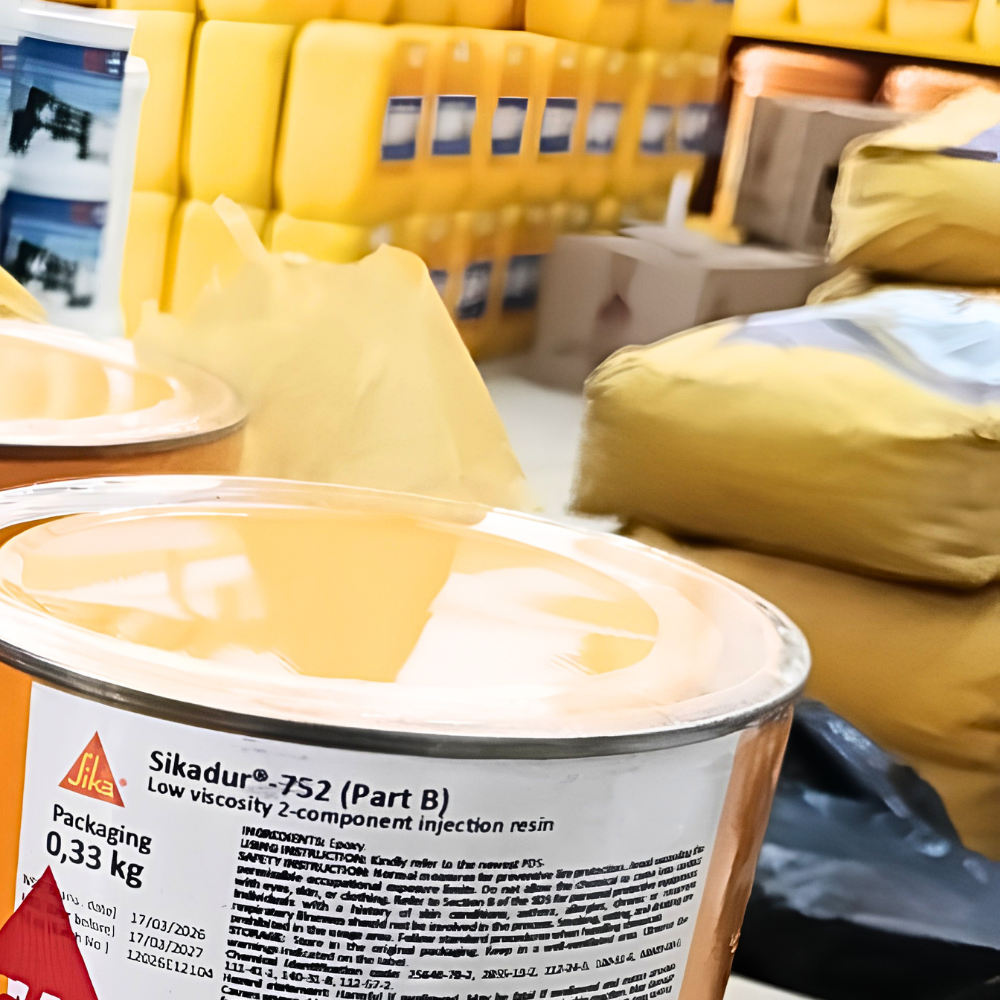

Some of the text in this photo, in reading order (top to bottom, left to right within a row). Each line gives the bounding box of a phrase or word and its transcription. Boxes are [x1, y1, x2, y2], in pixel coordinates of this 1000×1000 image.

[67, 752, 114, 798] Sika
[341, 780, 412, 810] (Part
[420, 787, 450, 818] B)
[52, 804, 153, 854] Packaging
[148, 777, 555, 837] Low viscosity 2-component injection resin
[46, 831, 145, 888] 0,33 kg
